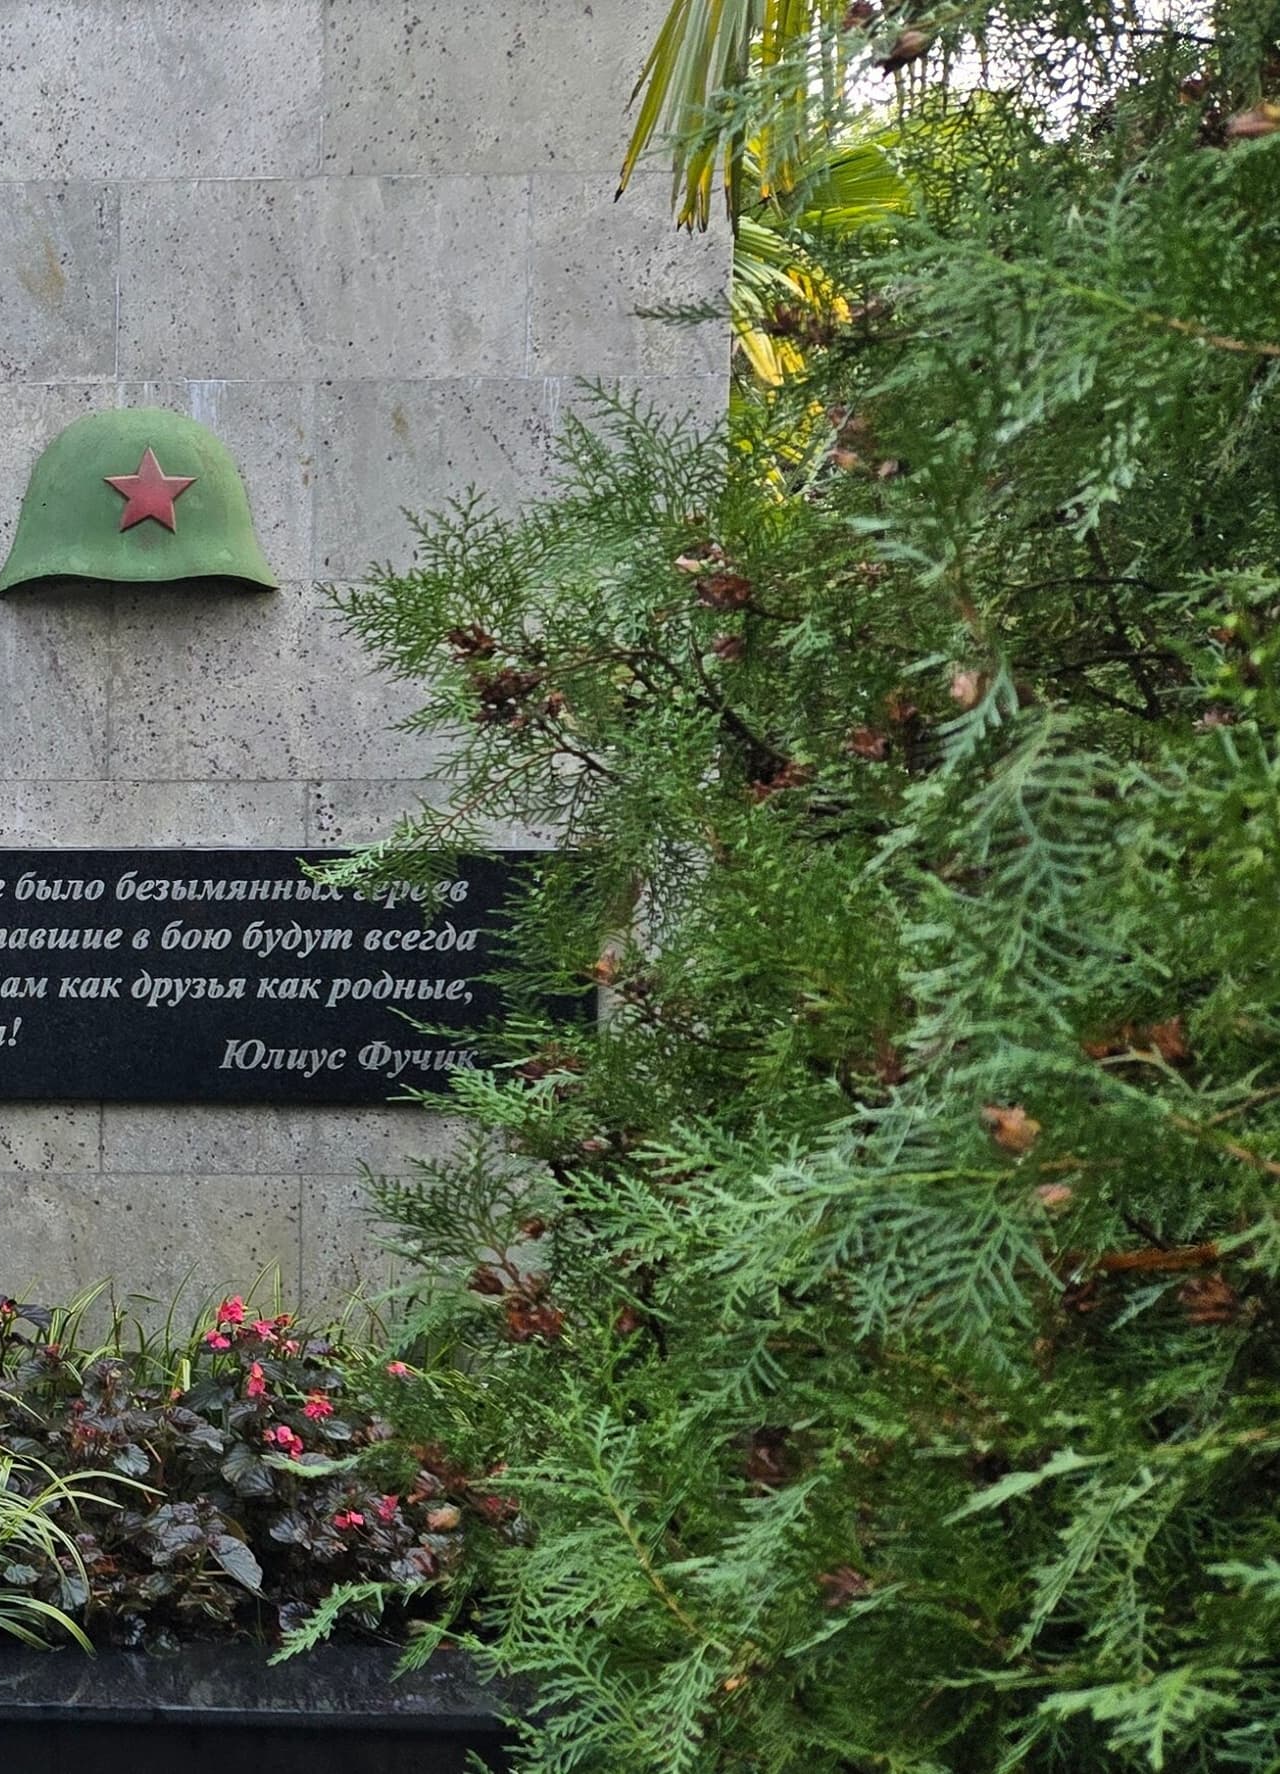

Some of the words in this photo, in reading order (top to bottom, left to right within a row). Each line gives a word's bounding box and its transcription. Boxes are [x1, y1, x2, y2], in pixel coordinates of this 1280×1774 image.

[14, 871, 105, 900] было
[115, 870, 343, 901] безымянных
[131, 928, 150, 950] в
[160, 919, 232, 950] бою
[242, 919, 353, 958] будут
[363, 920, 477, 951] всегда
[58, 977, 122, 998] как
[131, 968, 246, 1007] друзья
[256, 977, 322, 999] как
[324, 970, 473, 1007] родные,
[219, 1039, 346, 1078] Юлиус
[358, 1040, 479, 1078] Фучик
